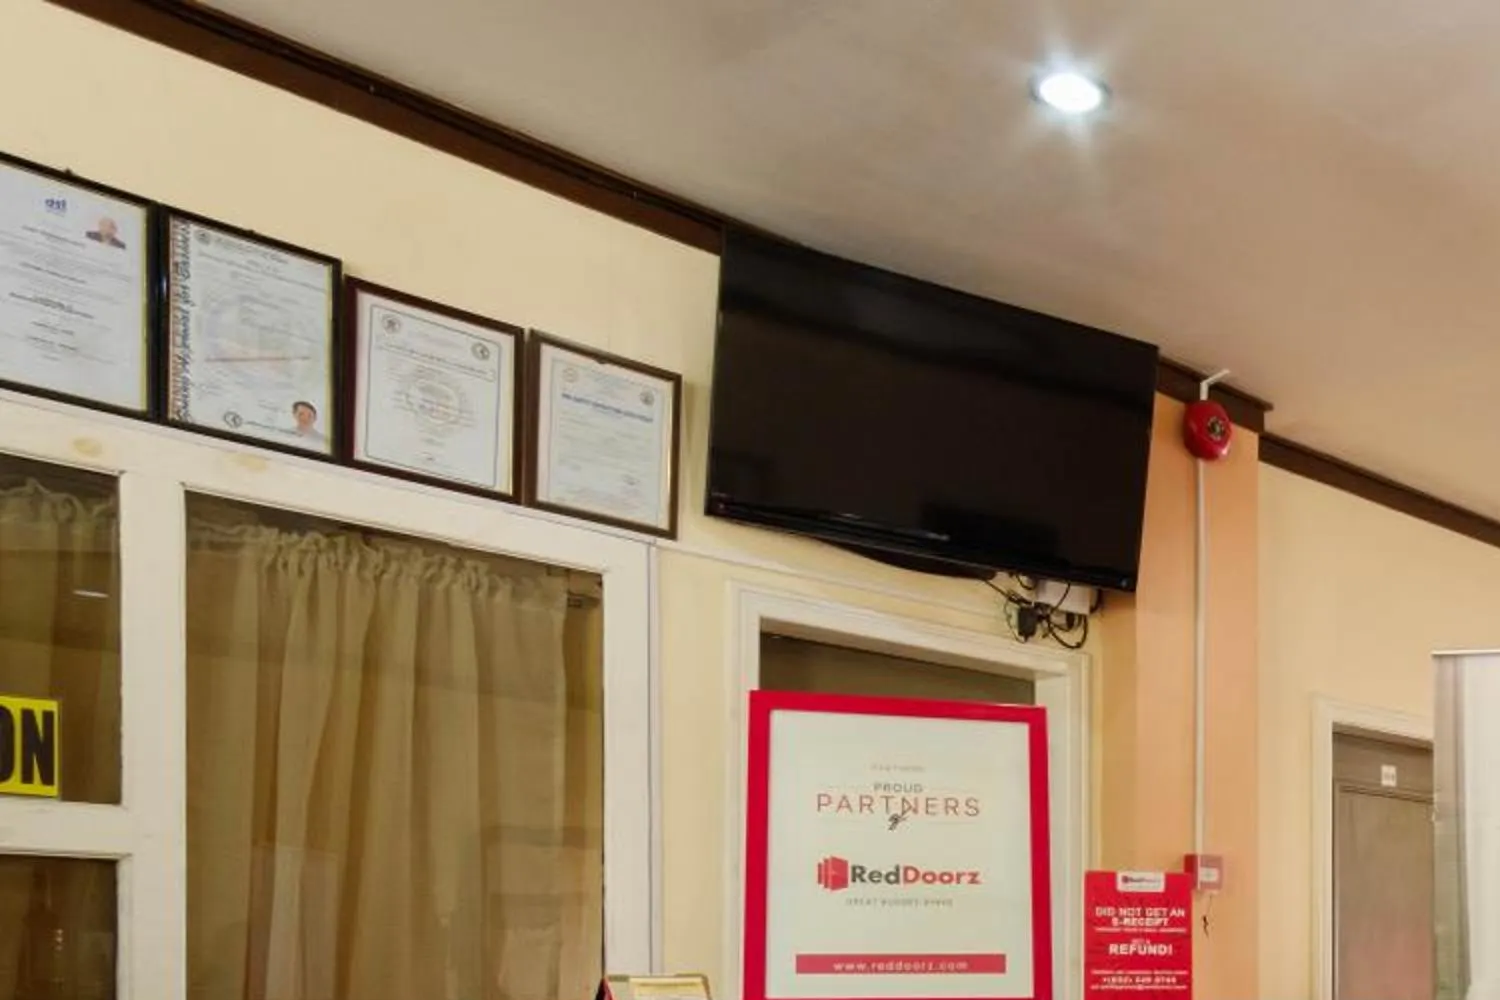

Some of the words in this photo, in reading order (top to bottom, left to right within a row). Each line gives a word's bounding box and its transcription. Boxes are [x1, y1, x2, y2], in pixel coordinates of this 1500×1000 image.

[874, 782, 924, 798] PROUD
[816, 793, 981, 818] PARTNERS
[850, 865, 982, 885] RedDoorz
[1118, 907, 1141, 918] NOT
[1169, 908, 1185, 918] AN
[1108, 943, 1173, 956] REFUND!
[833, 960, 968, 973] www.reddoorz.com
